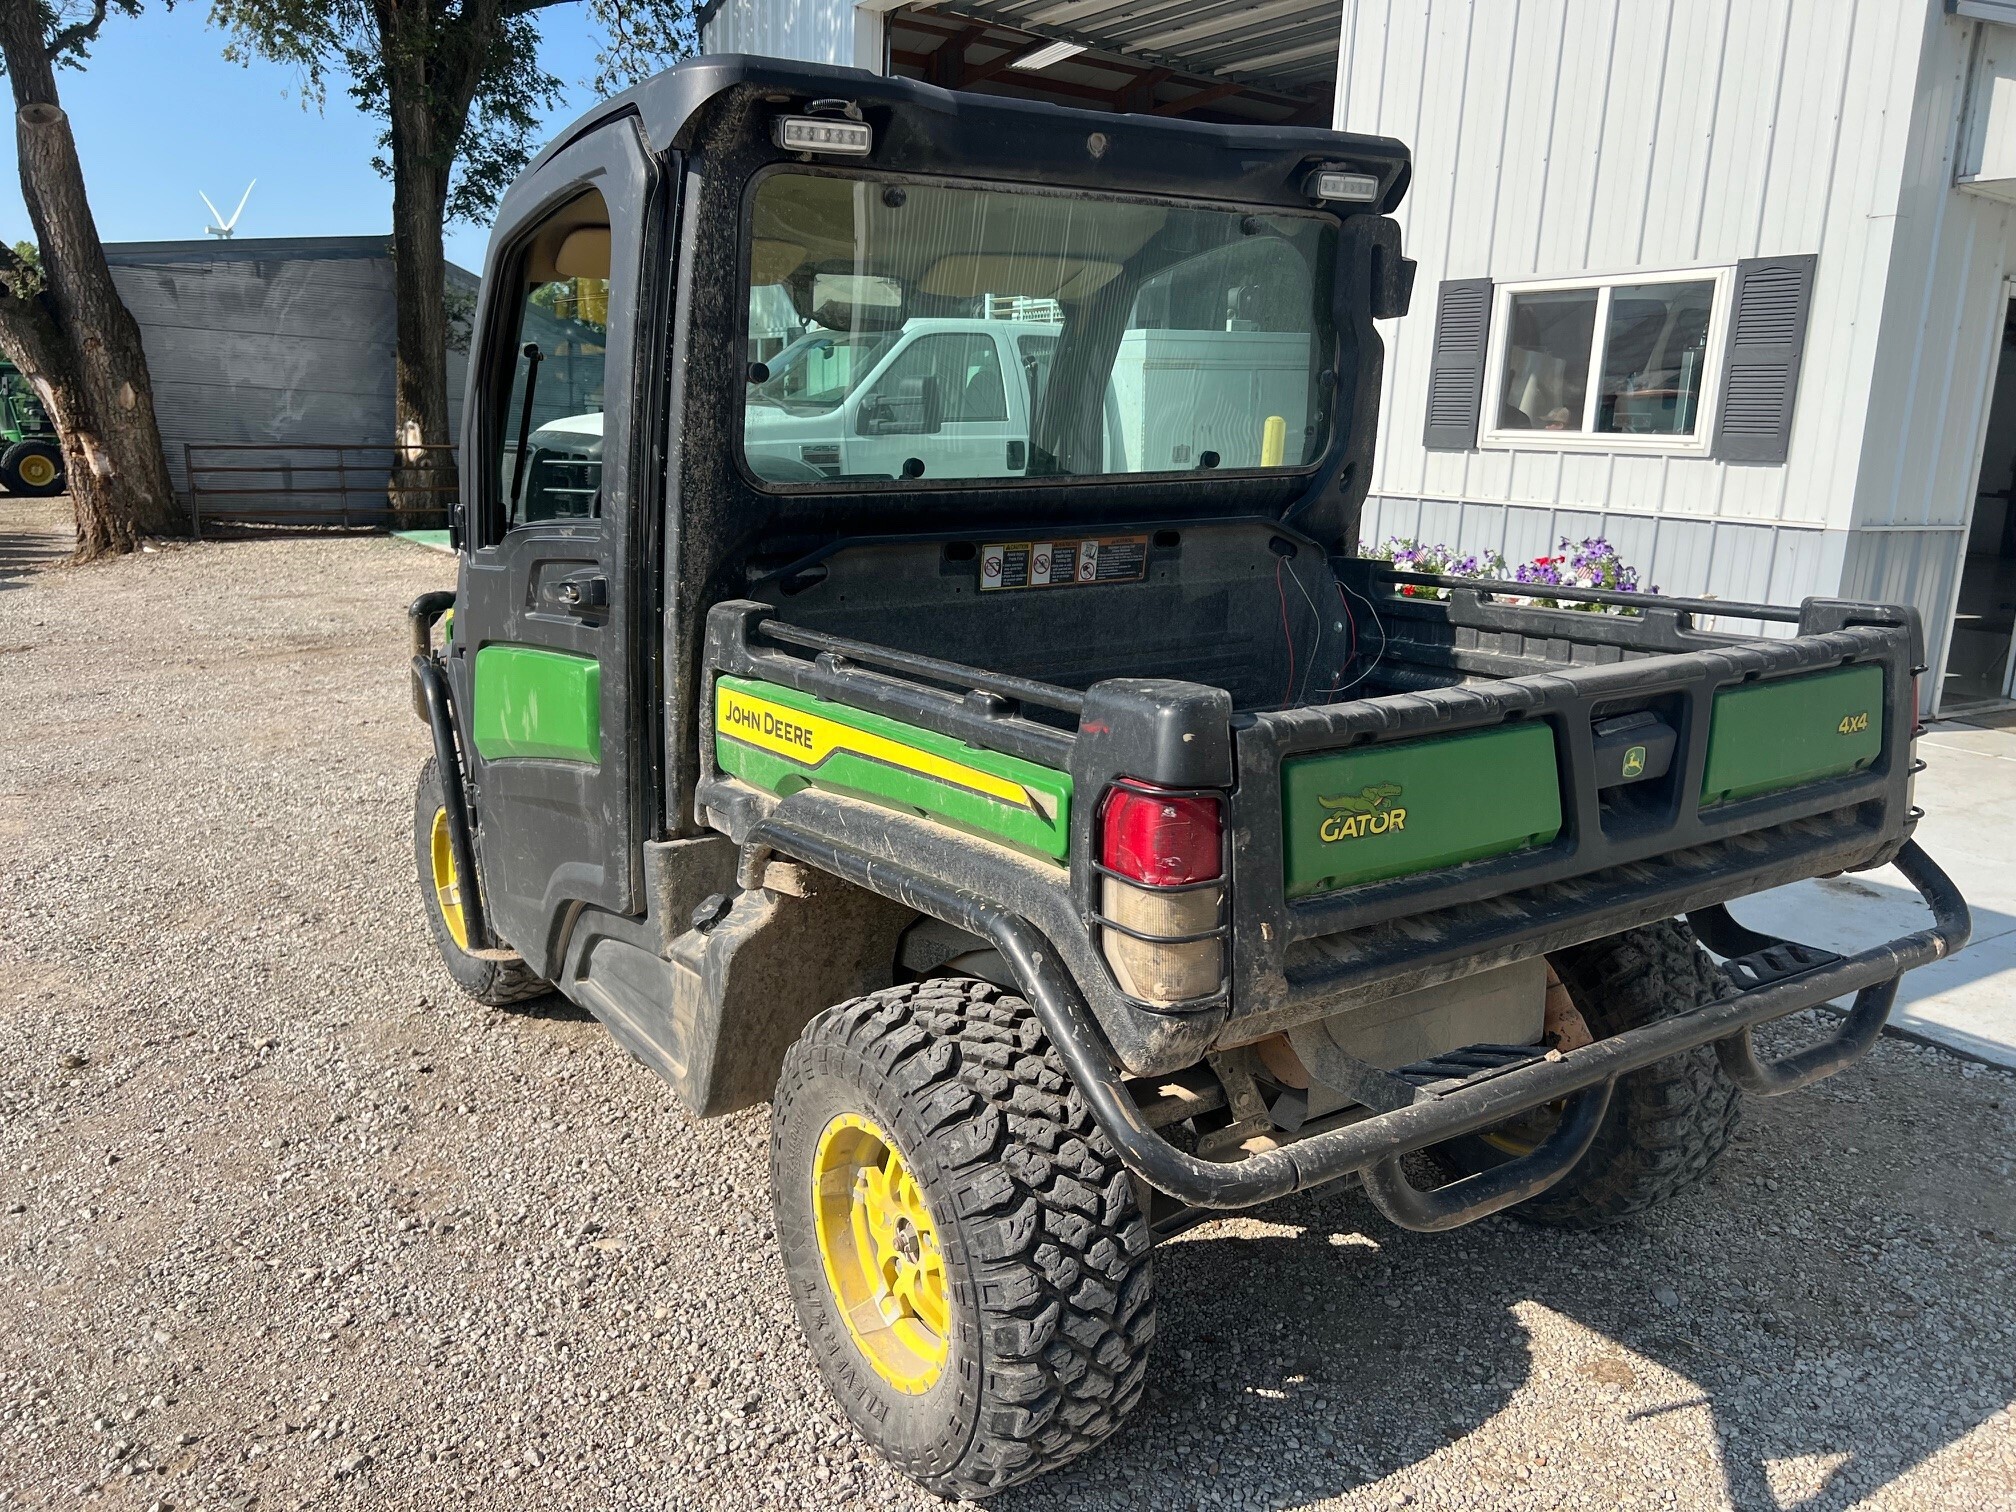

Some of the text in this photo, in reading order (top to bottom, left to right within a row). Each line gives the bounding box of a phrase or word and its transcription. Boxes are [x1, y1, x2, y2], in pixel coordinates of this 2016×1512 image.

[725, 700, 813, 749] JOHN DEERE
[1838, 712, 1868, 734] 4X4
[1319, 807, 1407, 842] GATOR
[823, 1332, 890, 1423] KLEVER
